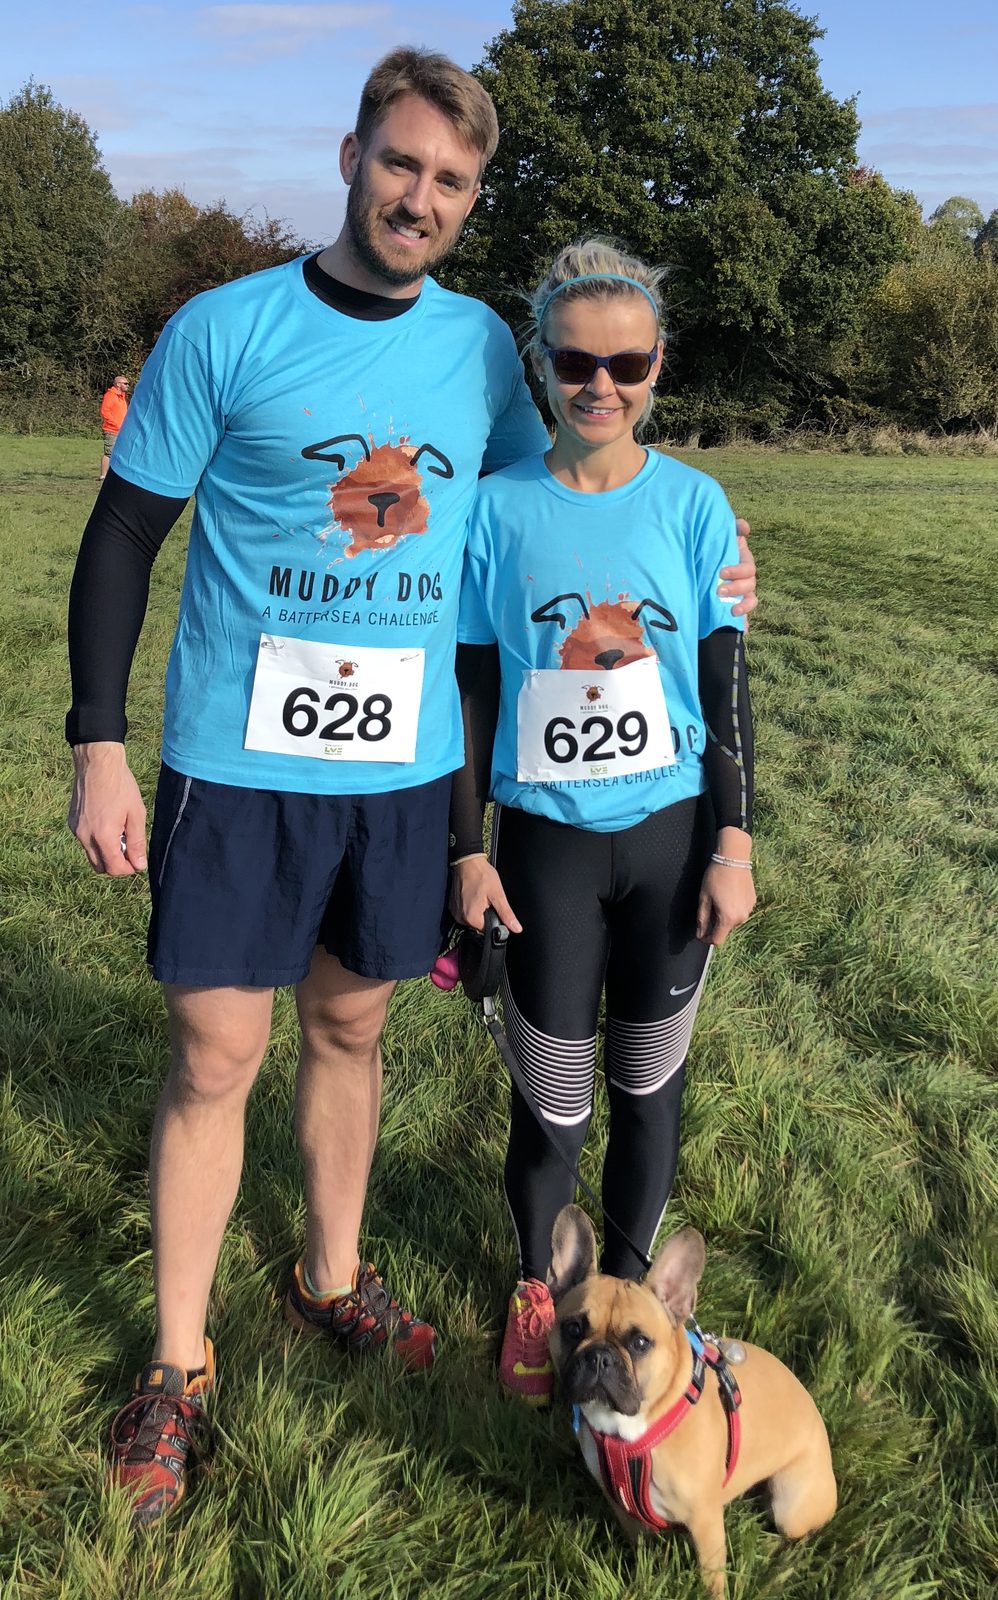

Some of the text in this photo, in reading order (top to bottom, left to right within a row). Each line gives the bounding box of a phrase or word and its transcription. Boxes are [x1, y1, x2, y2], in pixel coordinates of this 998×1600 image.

[269, 565, 443, 603] MUDDY DOG
[262, 605, 439, 627] A BATTERSEA CHALLENGE
[282, 686, 393, 742] 628
[543, 710, 649, 764] 629
